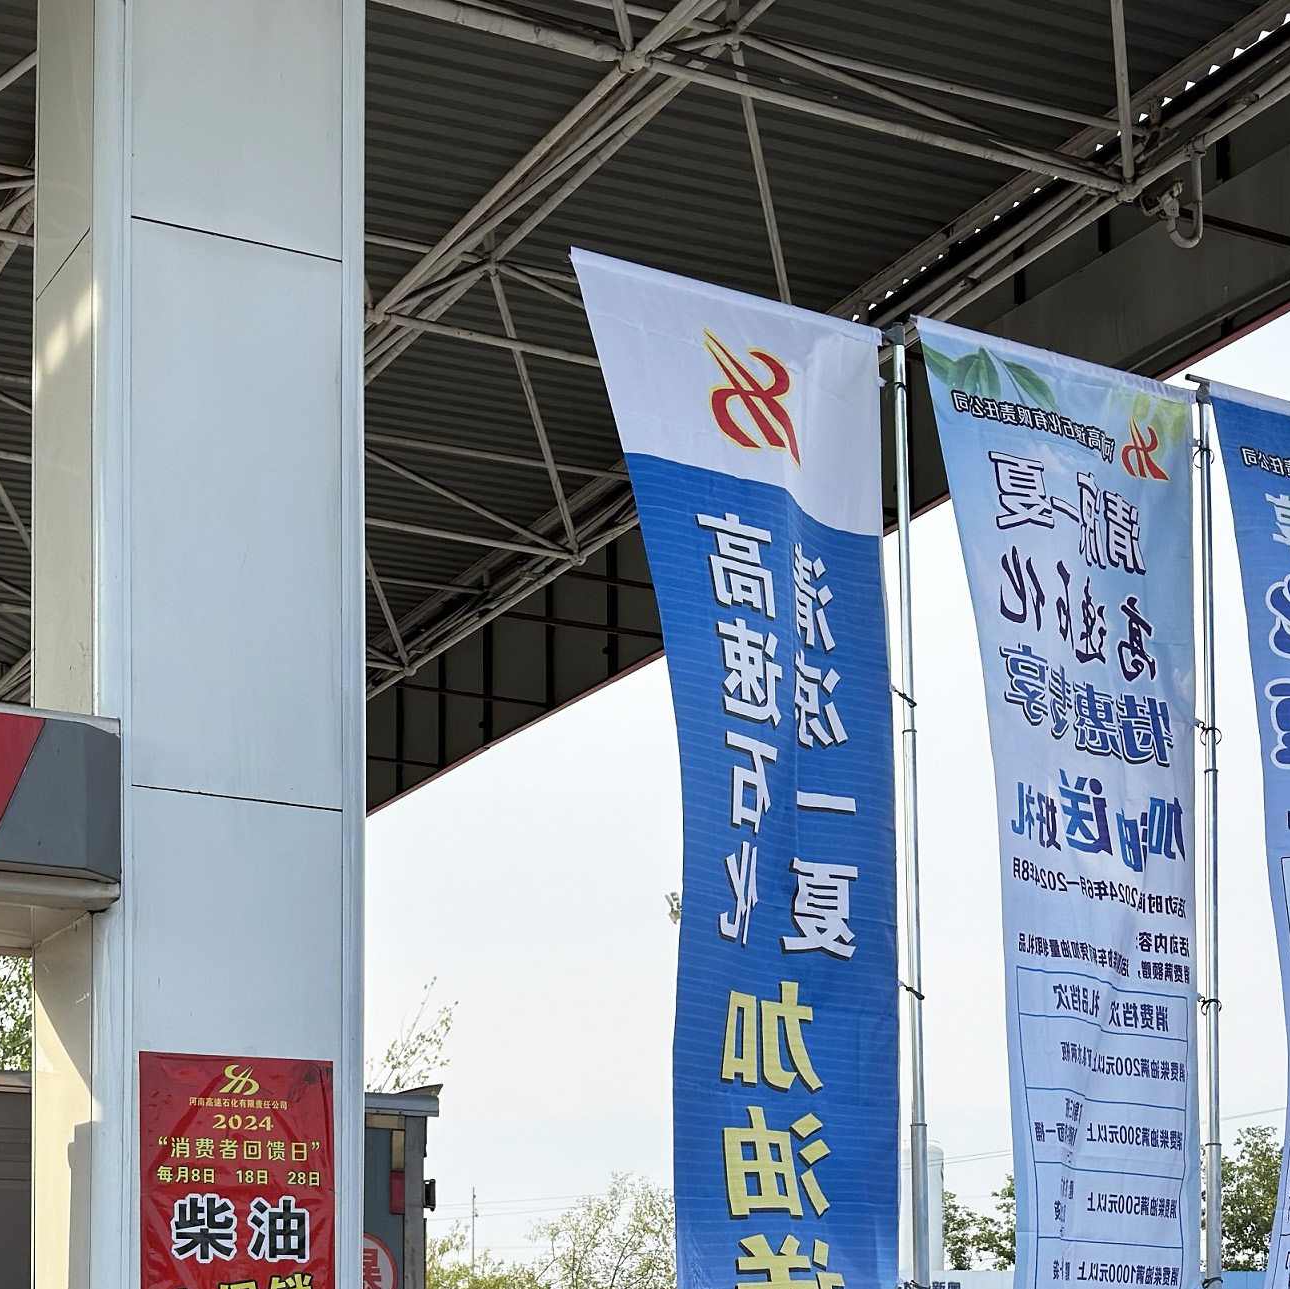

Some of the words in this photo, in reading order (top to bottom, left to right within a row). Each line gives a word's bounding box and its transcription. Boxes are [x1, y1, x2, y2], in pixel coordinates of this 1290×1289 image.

[189, 1097, 288, 1110] 河南高速石化有限责任公司
[212, 1114, 274, 1131] 2024
[158, 1135, 320, 1162] “消费者回馈日”
[157, 1165, 216, 1184] 每月8日
[236, 1169, 269, 1185] 18日
[287, 1171, 321, 1187] 28日
[173, 1196, 309, 1261] 柴油
